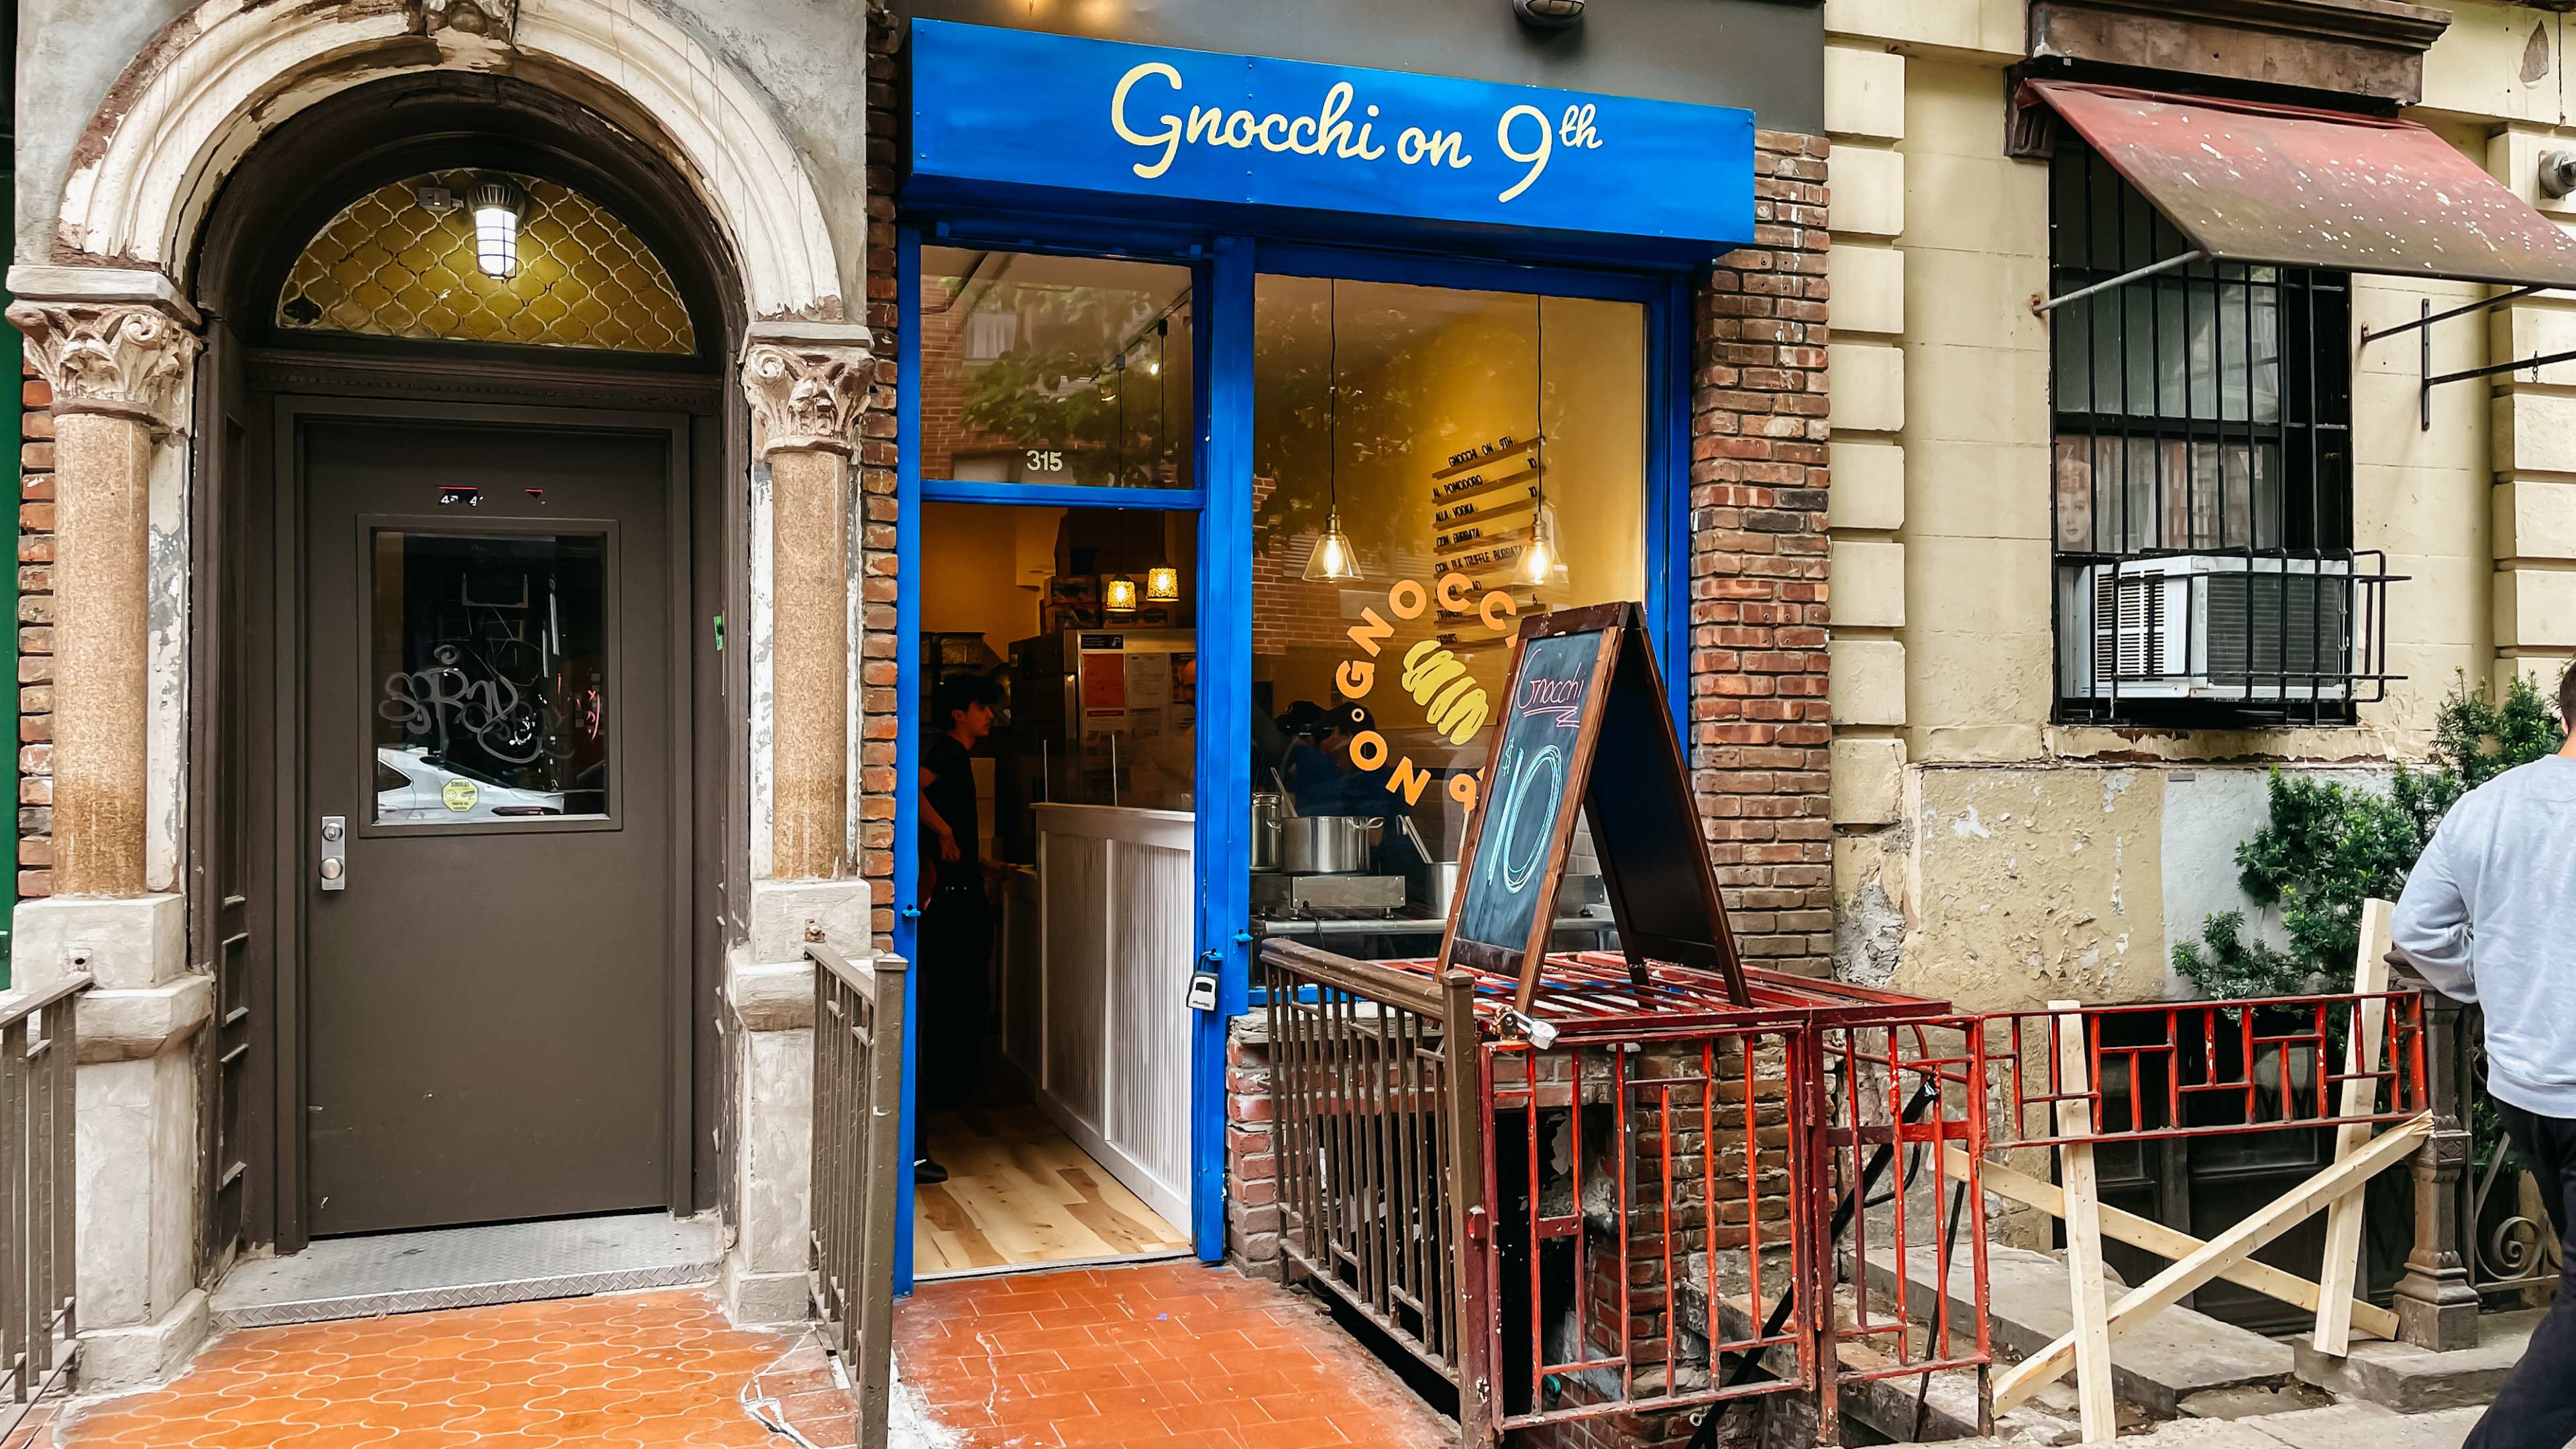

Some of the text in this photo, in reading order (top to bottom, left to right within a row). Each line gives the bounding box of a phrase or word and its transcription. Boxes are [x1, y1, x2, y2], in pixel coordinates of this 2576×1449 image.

[1111, 62, 1603, 203] Gnocchi on 9th
[1026, 449, 1063, 471] 315
[1448, 435, 1514, 467] GNOCCHI ON 9TH
[1444, 474, 1483, 495] POMODORO
[1436, 510, 1449, 523] ALLA
[1452, 502, 1475, 518] VODKA
[1336, 572, 1517, 699] GNOCC
[1517, 648, 1586, 709] Gnocchi
[1350, 730, 1431, 806] ON
